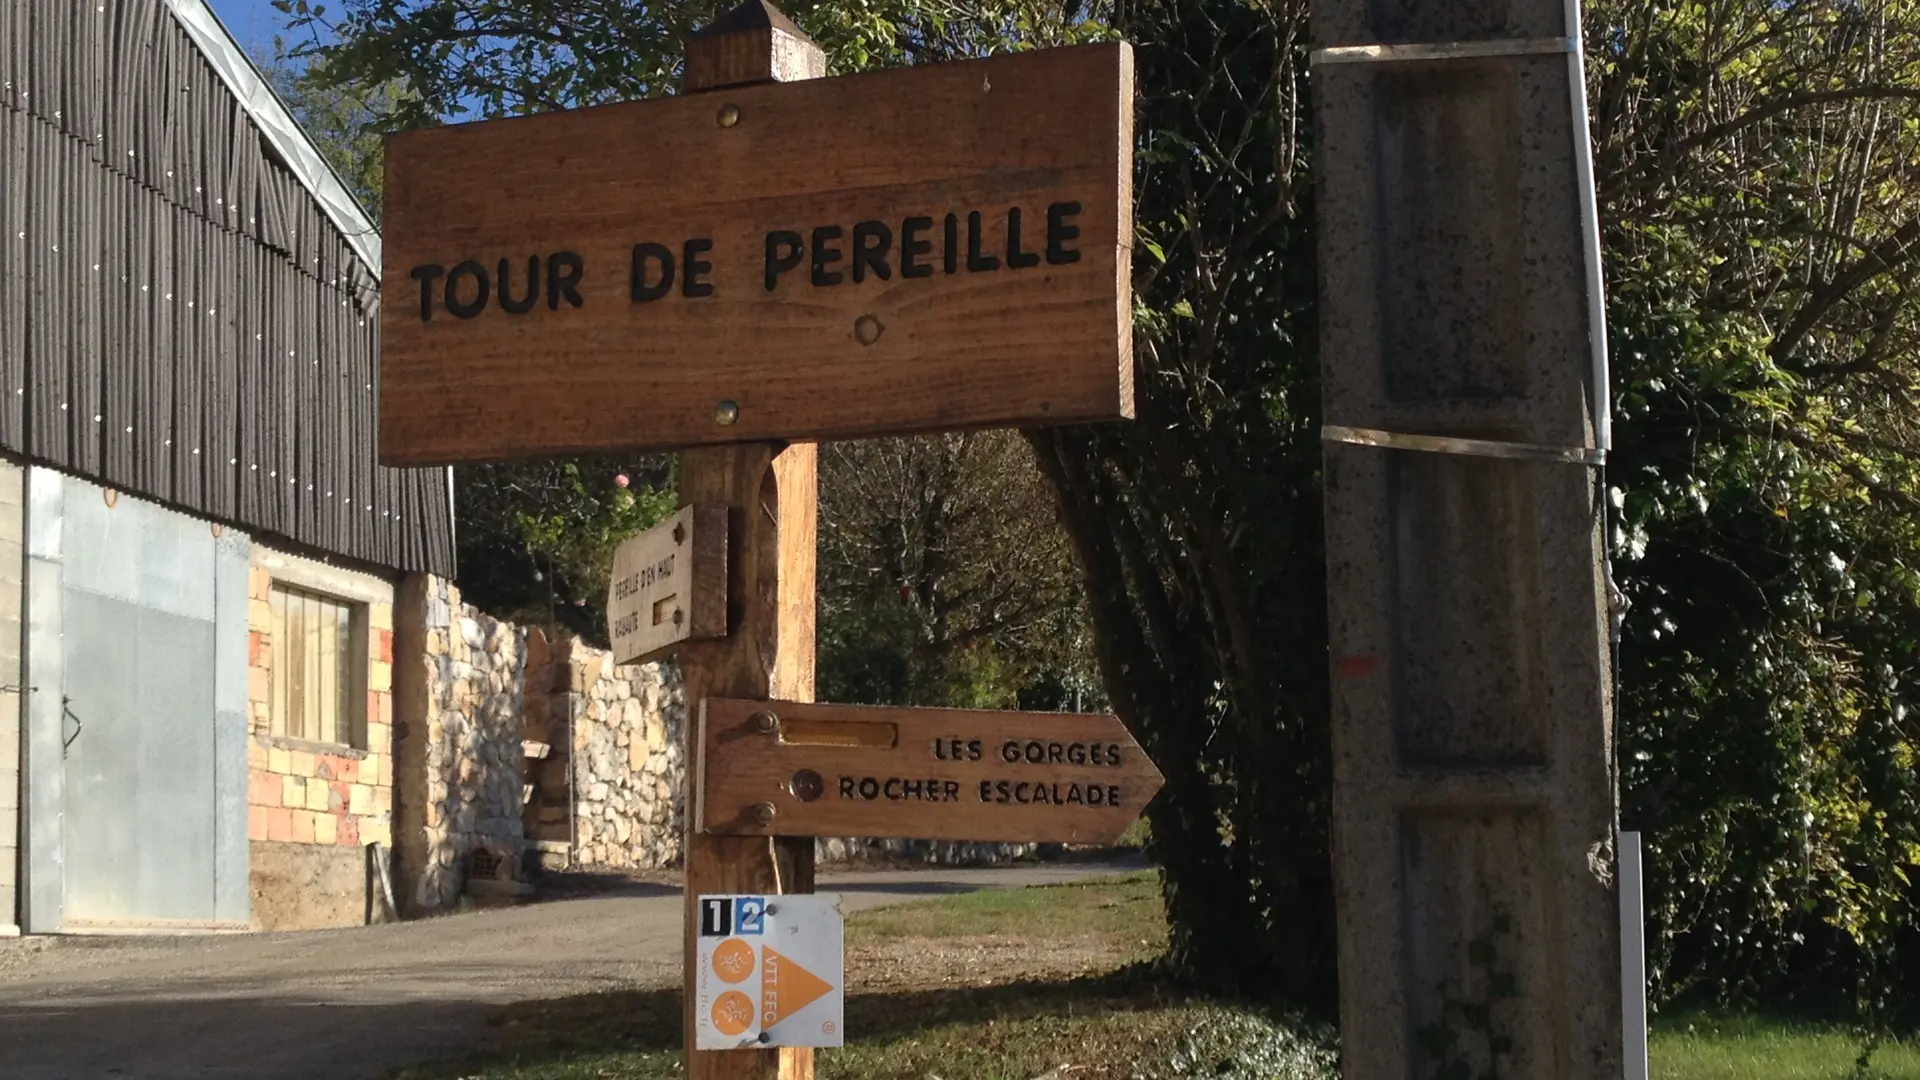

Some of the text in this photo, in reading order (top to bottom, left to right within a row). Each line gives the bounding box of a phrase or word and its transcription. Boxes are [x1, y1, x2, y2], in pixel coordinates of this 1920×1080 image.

[410, 201, 1082, 322] TOUR DE PEREILLE
[934, 738, 1121, 766] LES GORGES
[839, 777, 1120, 807] ROCHER ESCALADE
[709, 900, 760, 932] 1 2
[764, 955, 777, 1022] VTT FFC
